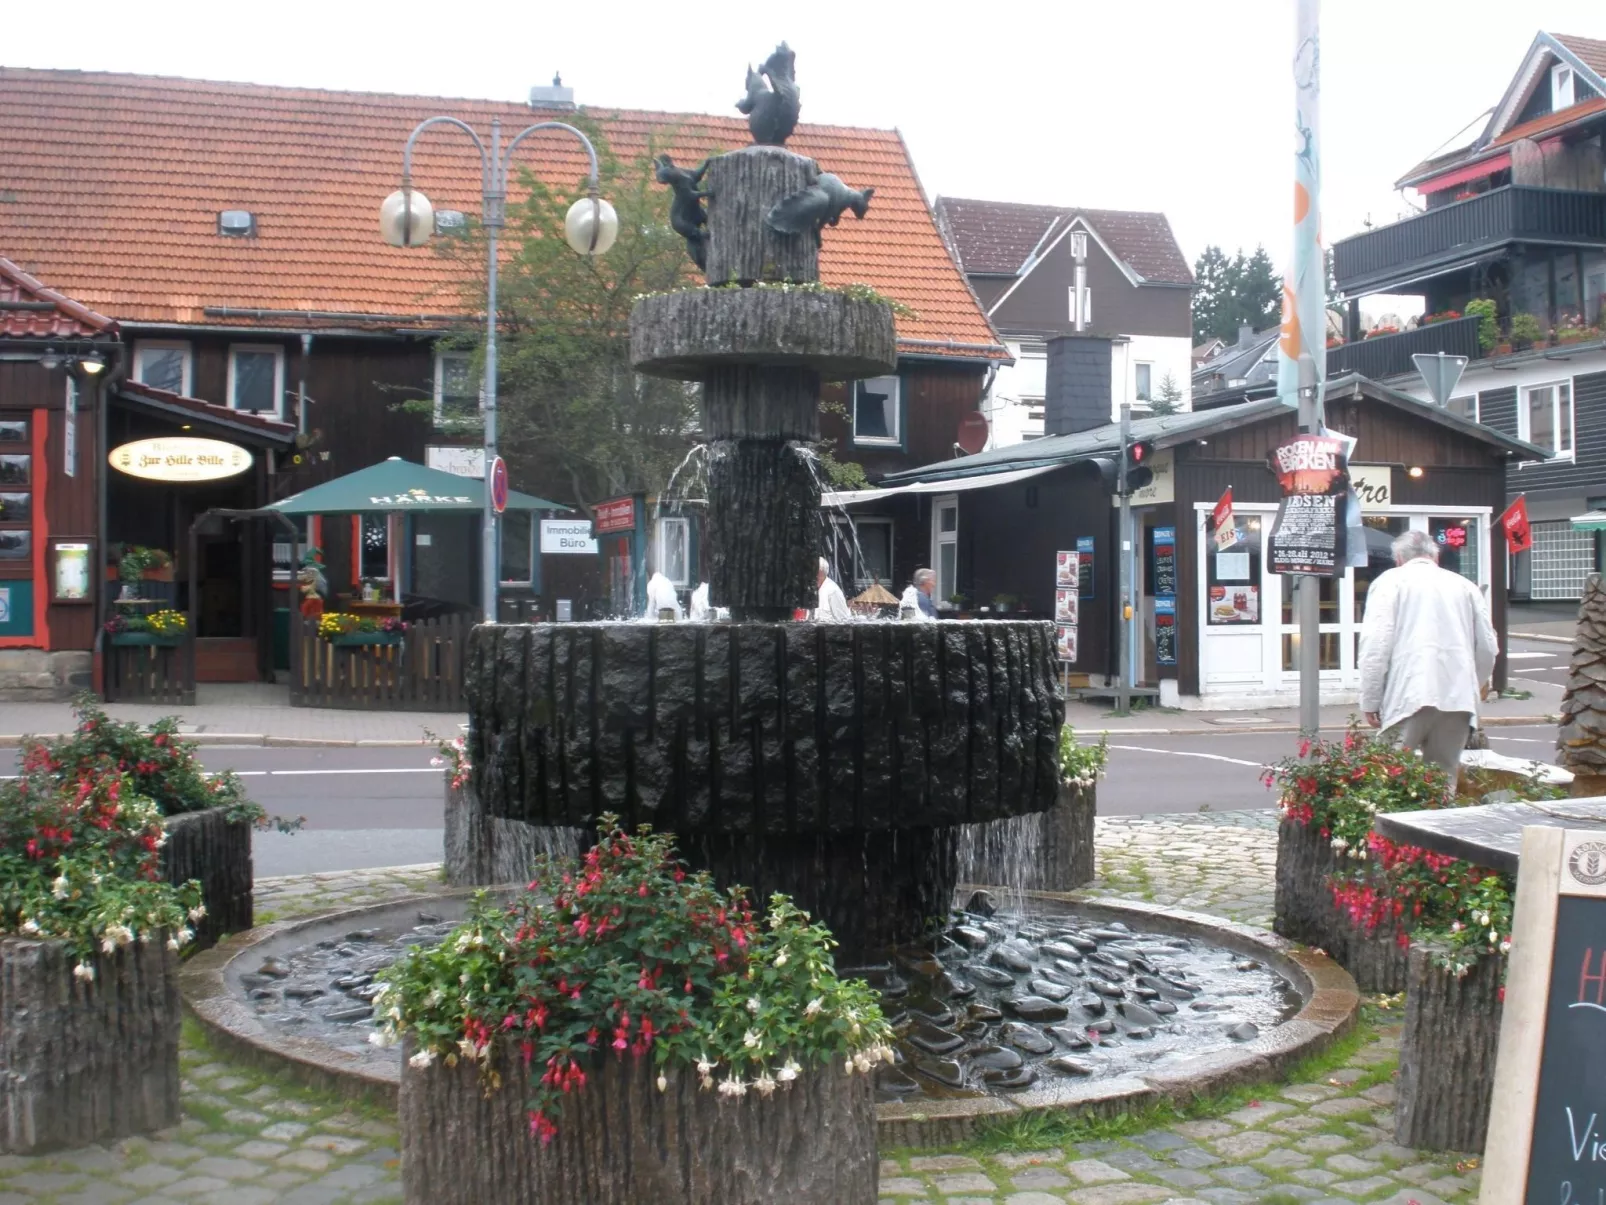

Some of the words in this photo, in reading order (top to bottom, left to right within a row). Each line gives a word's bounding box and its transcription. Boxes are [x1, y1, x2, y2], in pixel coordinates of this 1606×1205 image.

[139, 454, 161, 467] Zur
[165, 454, 193, 466] Hille
[197, 454, 225, 467] Bille
[1353, 477, 1389, 504] tro
[369, 493, 473, 504] HÄRKE
[546, 525, 592, 535] Immobilie
[1221, 529, 1235, 544] EIS
[559, 537, 586, 548] Büro
[1310, 550, 1329, 559] 2012
